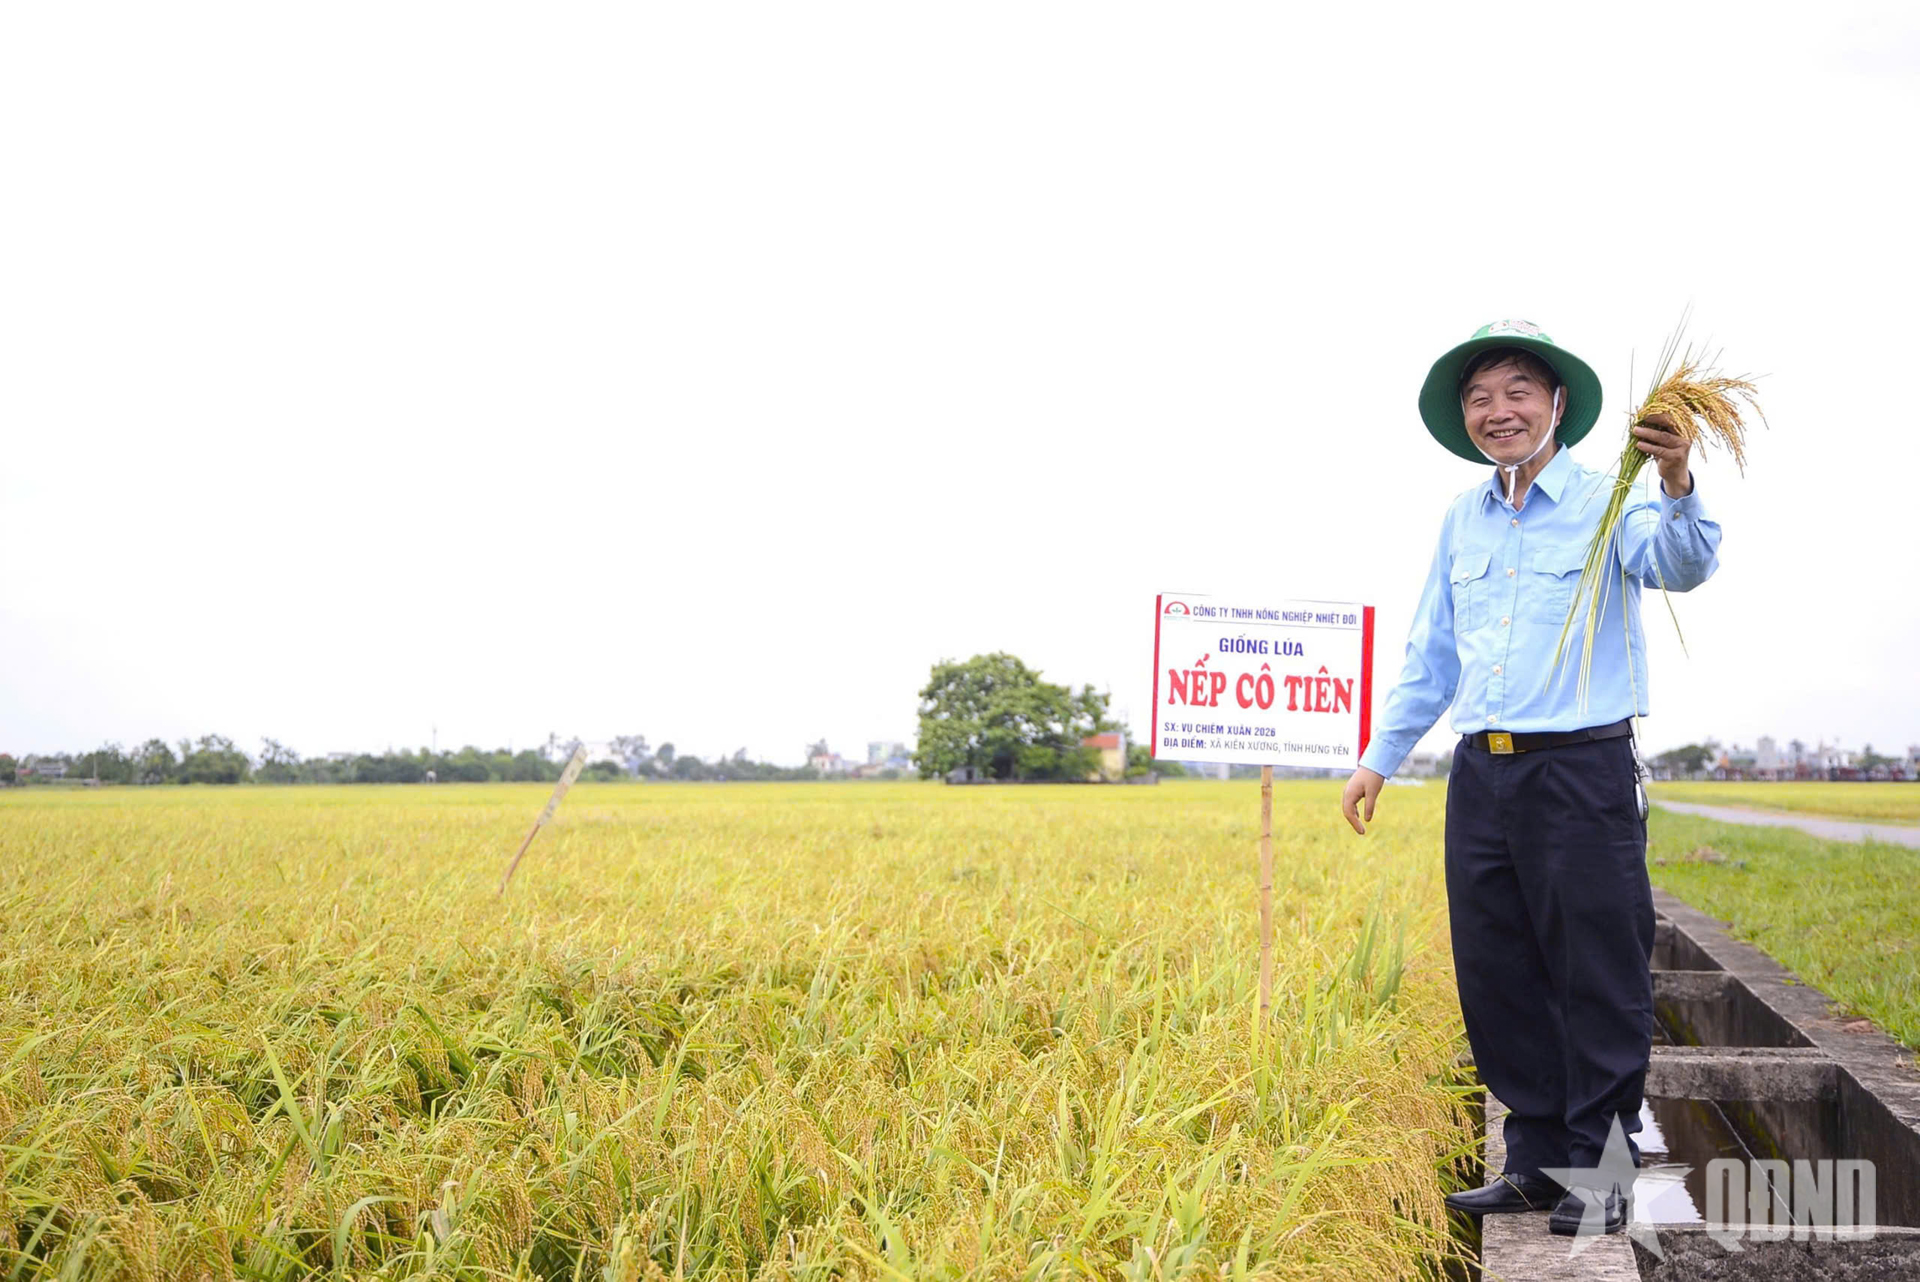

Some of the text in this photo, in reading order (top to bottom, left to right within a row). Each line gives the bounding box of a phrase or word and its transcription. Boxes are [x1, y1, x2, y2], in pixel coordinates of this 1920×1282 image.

[1193, 604, 1216, 617] CÔNG
[1219, 607, 1229, 618] TY
[1231, 607, 1253, 619] TNHH
[1256, 607, 1279, 620] NÔNG
[1282, 609, 1313, 624] NGHIỆP
[1316, 610, 1340, 625] NHIỆT
[1219, 633, 1304, 656] GIỐNG LÚA
[1168, 653, 1354, 714] NẾP CÔ TIÊN
[1164, 722, 1179, 732] SX:
[1181, 723, 1193, 735] VỤ
[1195, 722, 1224, 734] CHIÊM
[1227, 724, 1252, 736] XUÂN
[1163, 737, 1179, 749] ĐỊA
[1181, 735, 1207, 749] ĐIỂM:
[1304, 744, 1330, 755] HƯNG
[1332, 744, 1350, 756] YÊN
